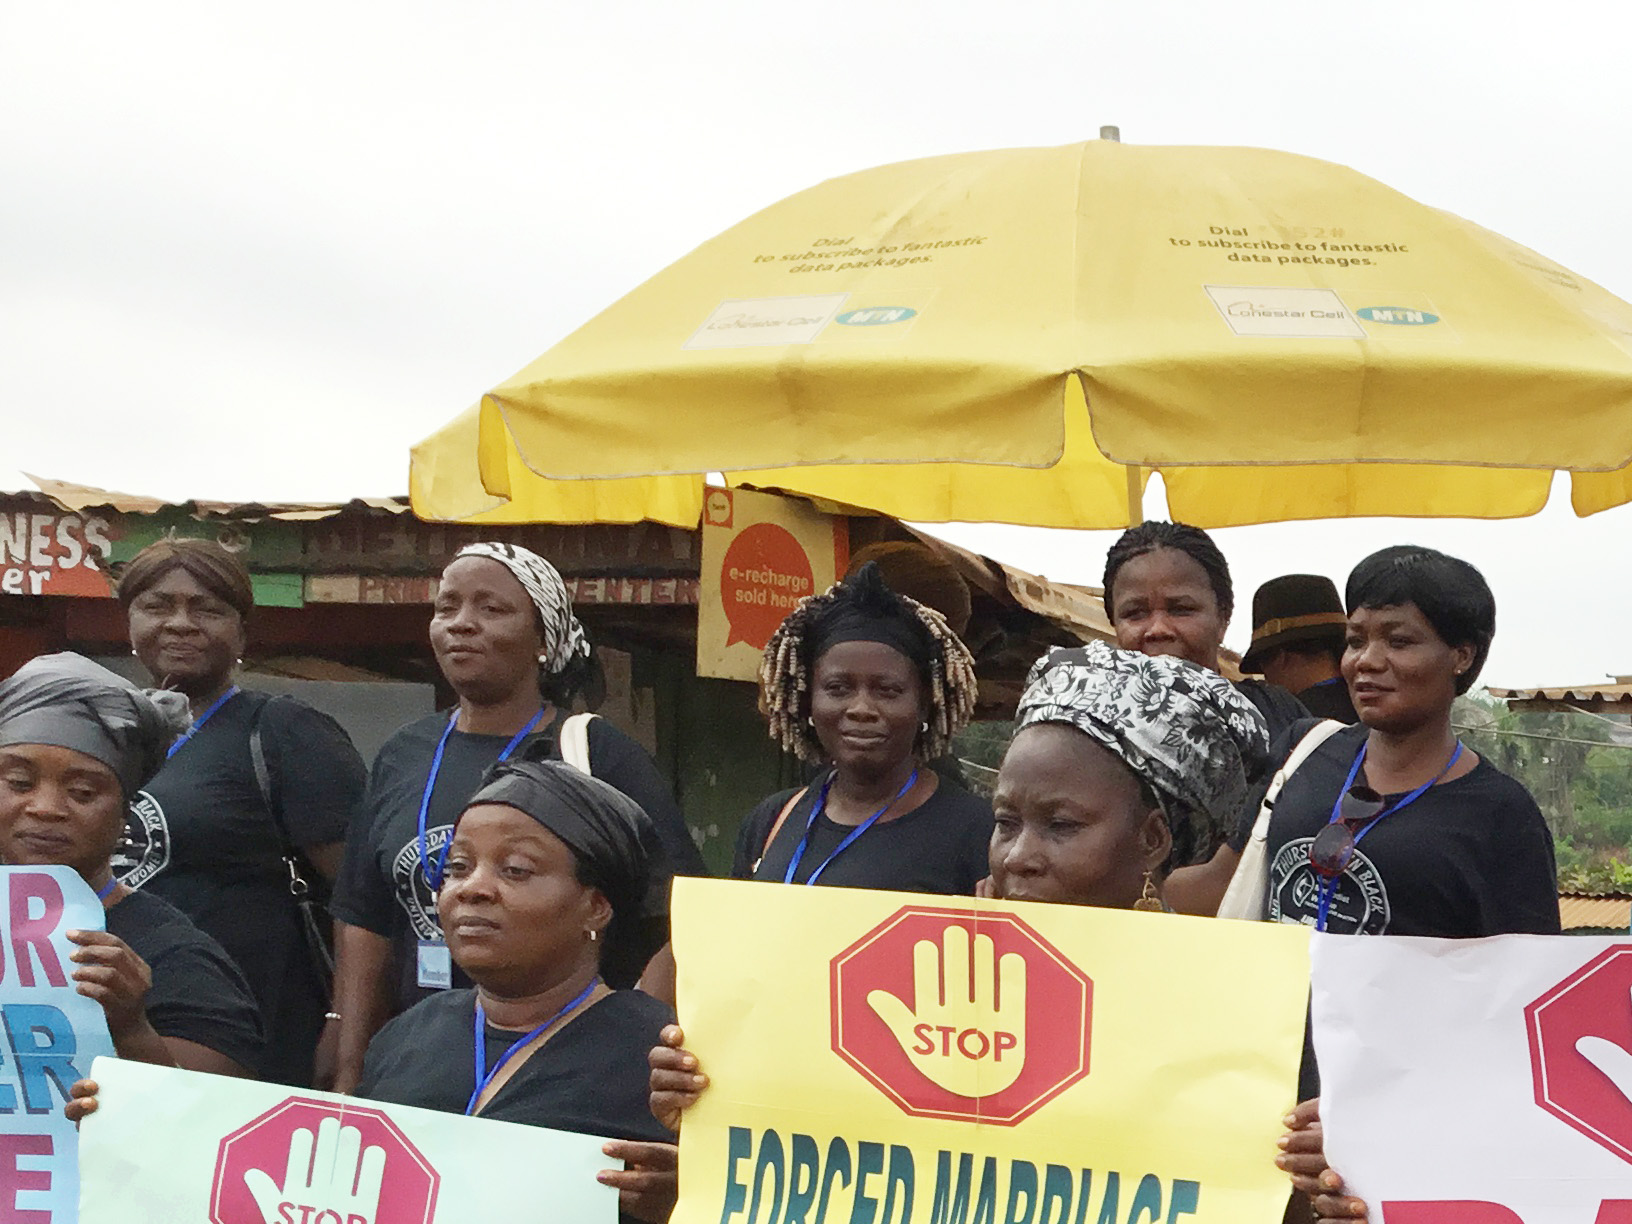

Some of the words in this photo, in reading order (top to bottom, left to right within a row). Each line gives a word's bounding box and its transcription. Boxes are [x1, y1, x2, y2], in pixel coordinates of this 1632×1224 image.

[1209, 226, 1248, 237] Dial
[753, 253, 775, 264] to
[778, 244, 874, 262] subscribe
[877, 243, 898, 255] to
[900, 234, 988, 252] fantastic
[811, 236, 854, 248] Dial
[1169, 237, 1191, 248] to
[1197, 238, 1291, 252] subscribe
[1295, 241, 1315, 252] to
[1320, 240, 1409, 254] fantastic
[789, 259, 834, 274] data
[1227, 252, 1272, 265] data
[1277, 254, 1377, 268] packages.
[847, 309, 907, 323] MTN
[1309, 309, 1345, 320] Cell
[1371, 308, 1425, 324] MTN
[1, 567, 50, 595] er
[728, 567, 809, 593] e-recharge
[735, 588, 768, 606] sold
[1358, 869, 1386, 915] BLACK
[0, 872, 69, 987] R
[909, 1023, 1018, 1063] STOP
